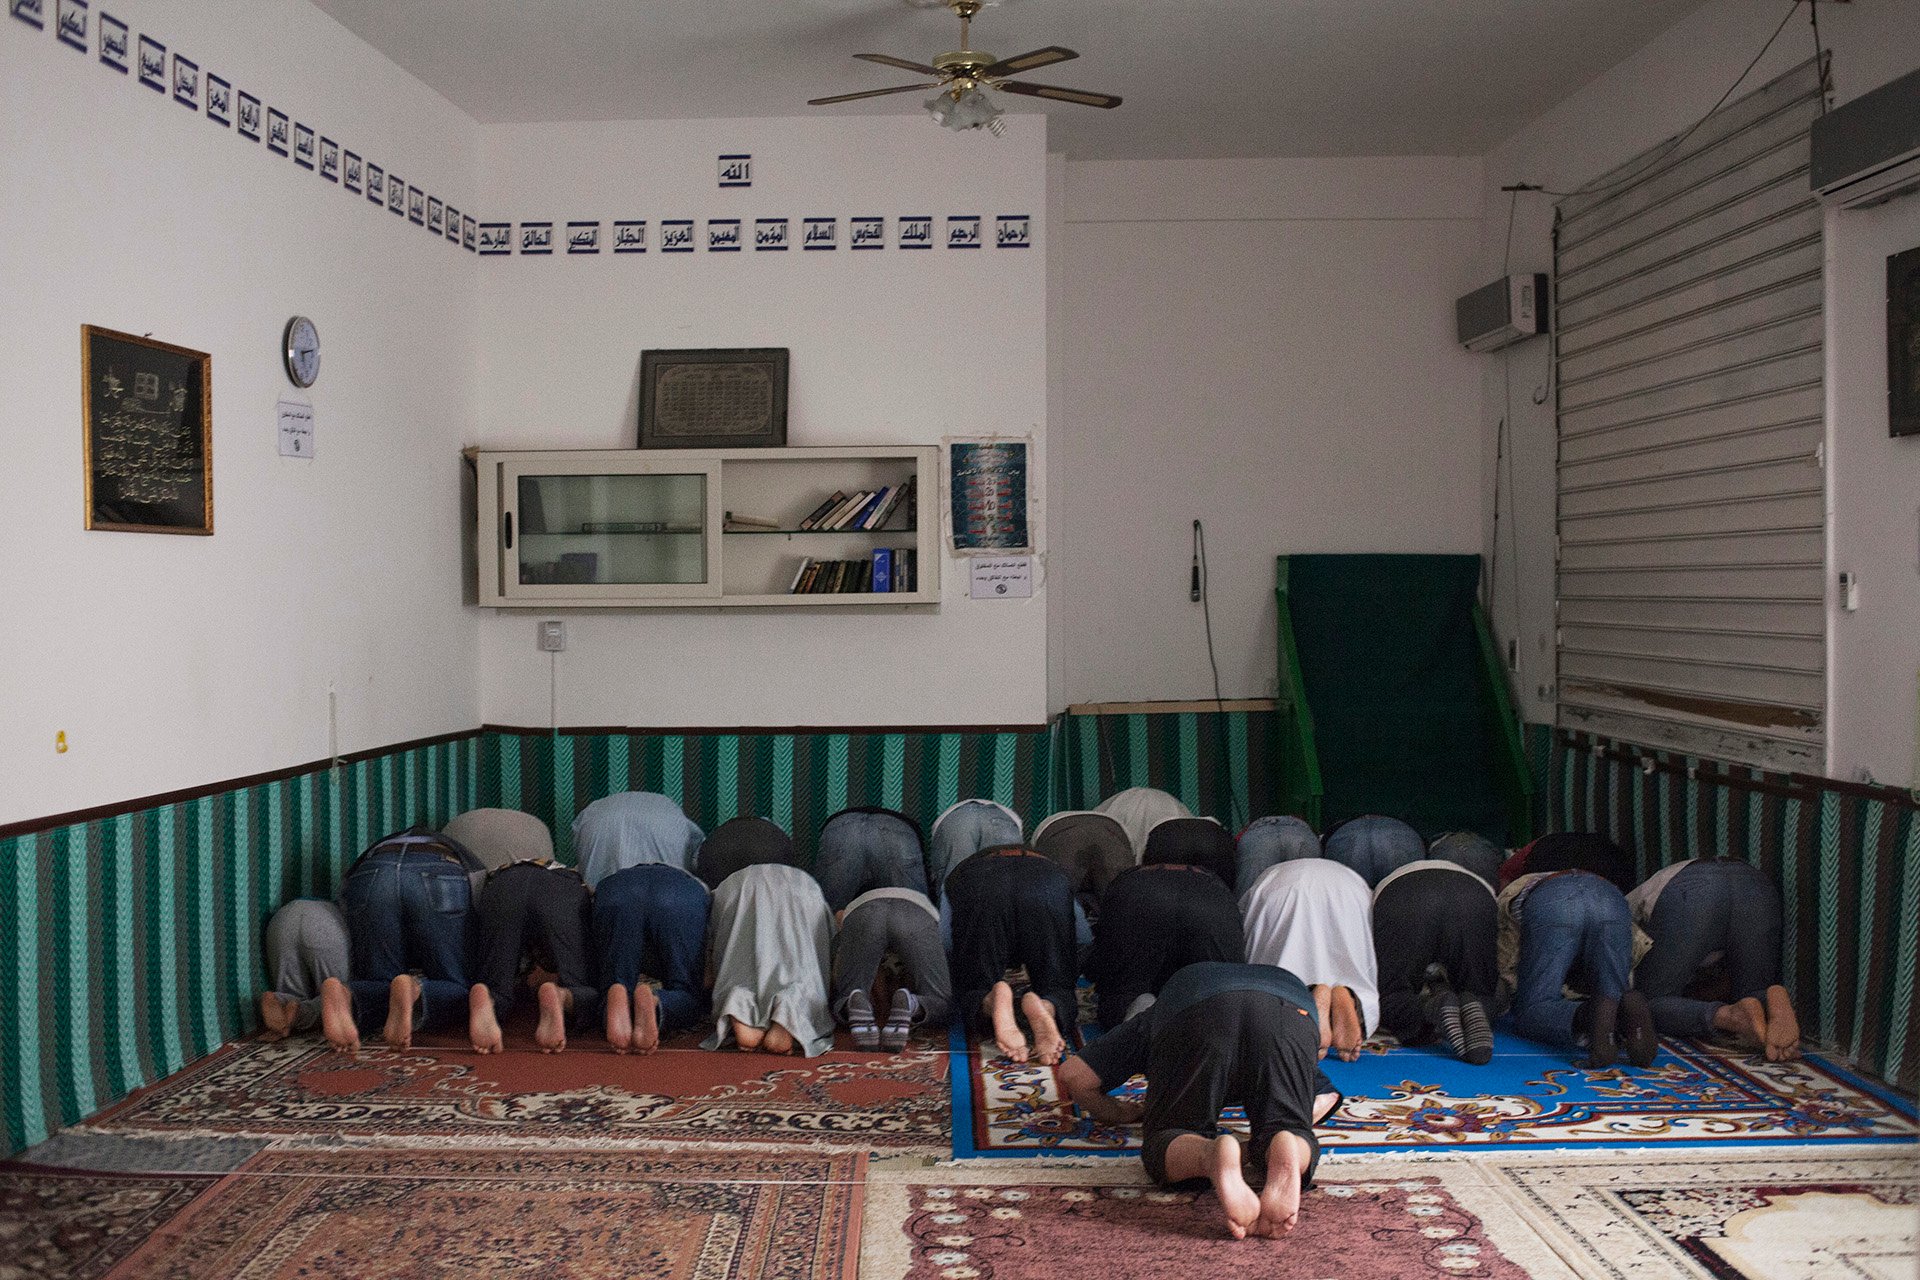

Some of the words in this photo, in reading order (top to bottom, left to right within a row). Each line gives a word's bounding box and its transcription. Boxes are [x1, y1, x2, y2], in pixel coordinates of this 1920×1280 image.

[720, 163, 749, 180] الله
[805, 223, 835, 243] السلام
[901, 222, 930, 242] الملك
[949, 222, 980, 243] الرحيم
